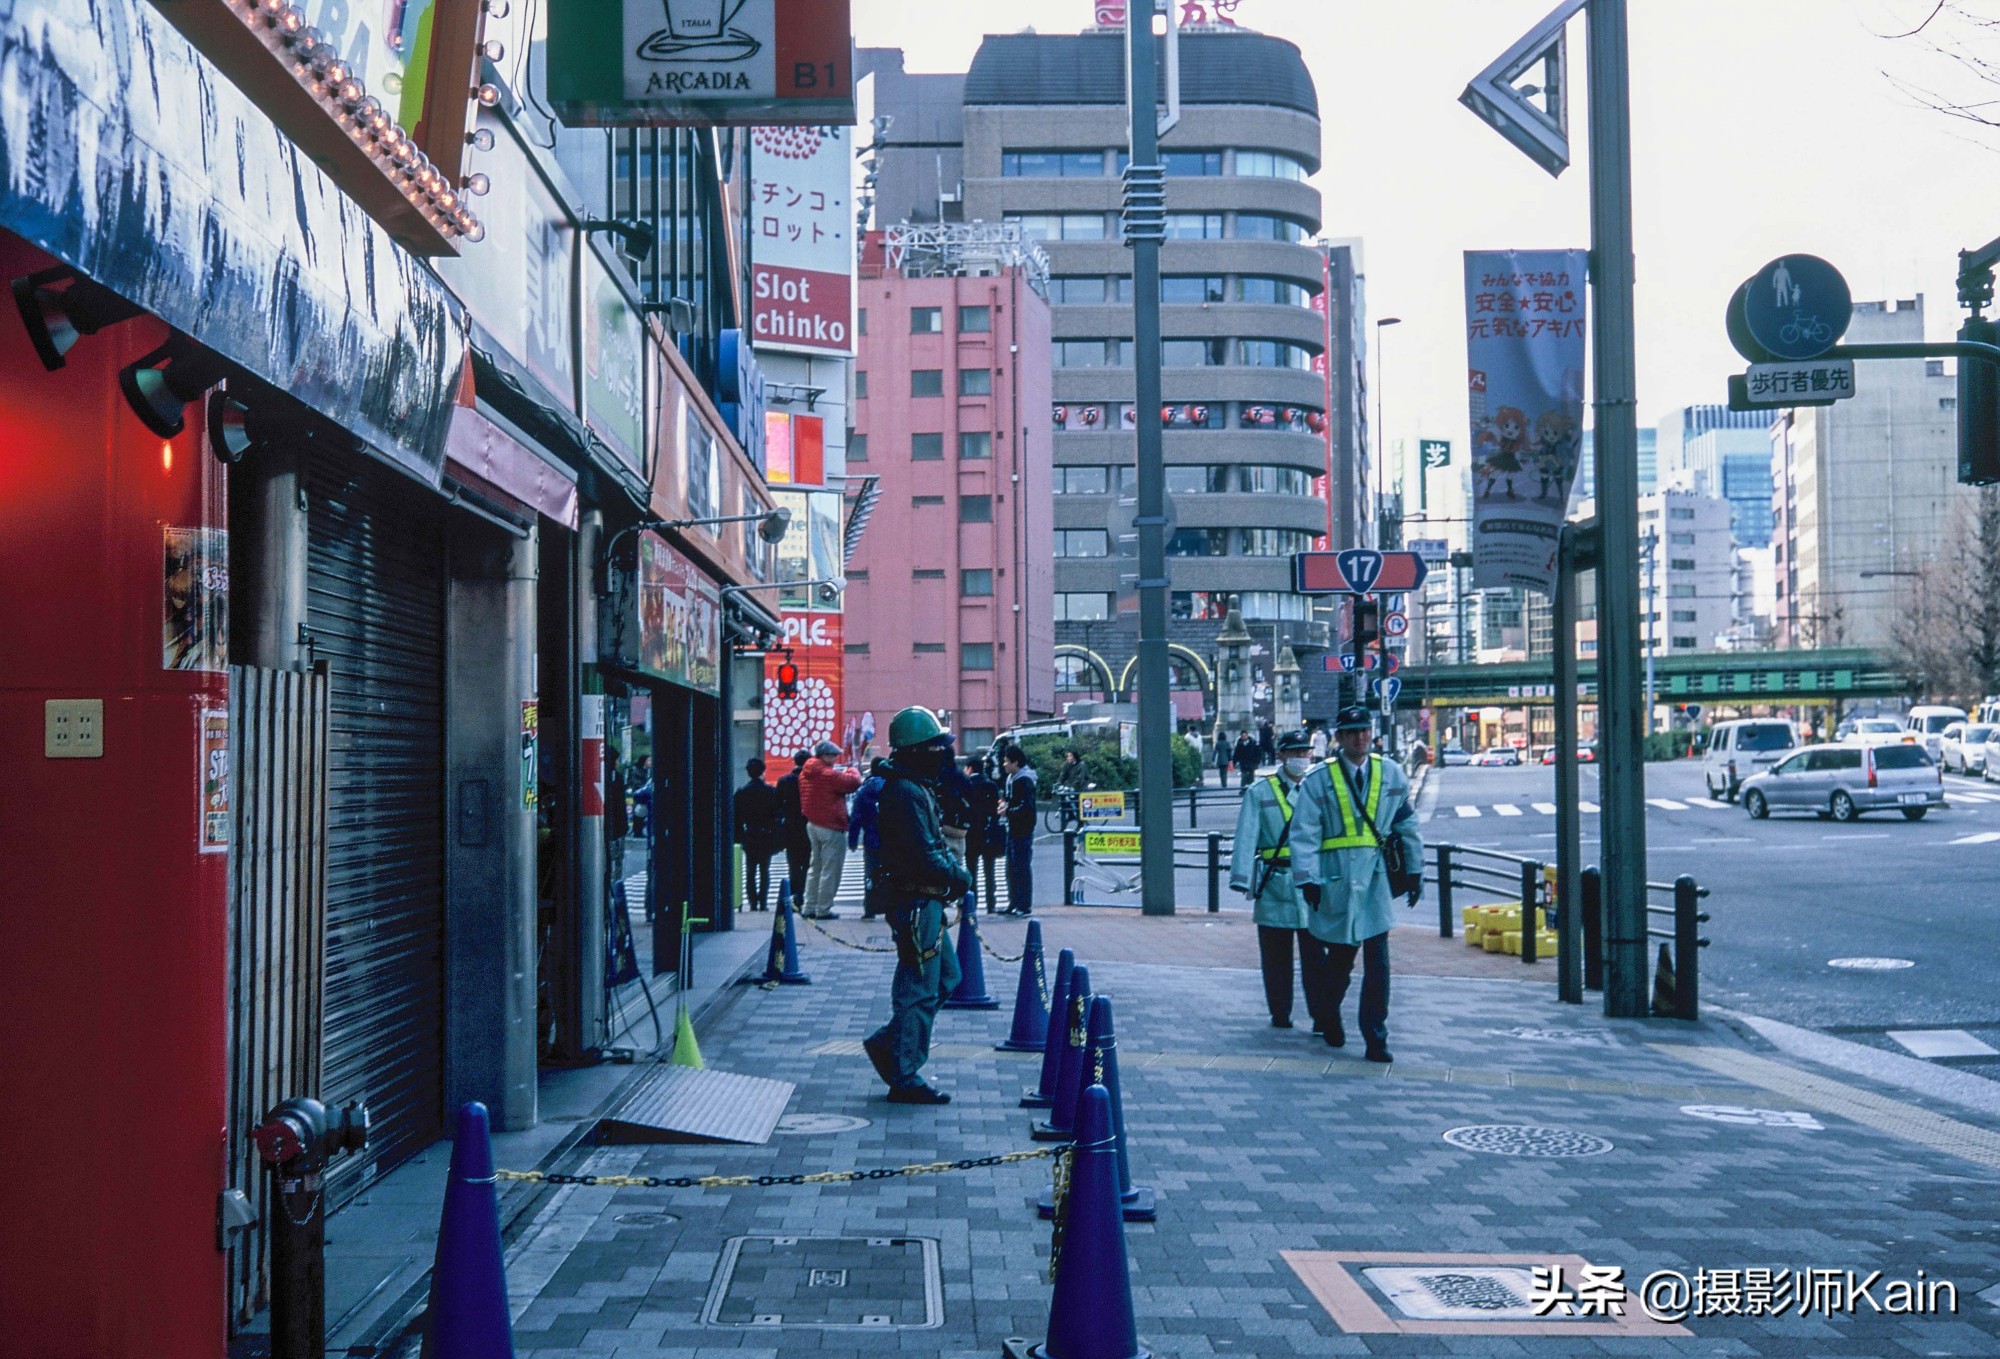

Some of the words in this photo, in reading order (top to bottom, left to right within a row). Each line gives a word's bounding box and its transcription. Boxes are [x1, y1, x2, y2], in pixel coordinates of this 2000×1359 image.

[681, 19, 712, 28] ITALIA
[645, 71, 751, 95] ARCADIA
[794, 62, 836, 89] B1
[752, 216, 840, 244] ロット・
[755, 271, 810, 303] Slot
[1482, 271, 1570, 287] みんなで協力
[755, 309, 845, 343] chinko
[1470, 316, 1584, 340] 元気なアキバ
[1751, 367, 1849, 395] 歩行者優先
[1347, 555, 1377, 583] 17
[1343, 655, 1356, 668] 17
